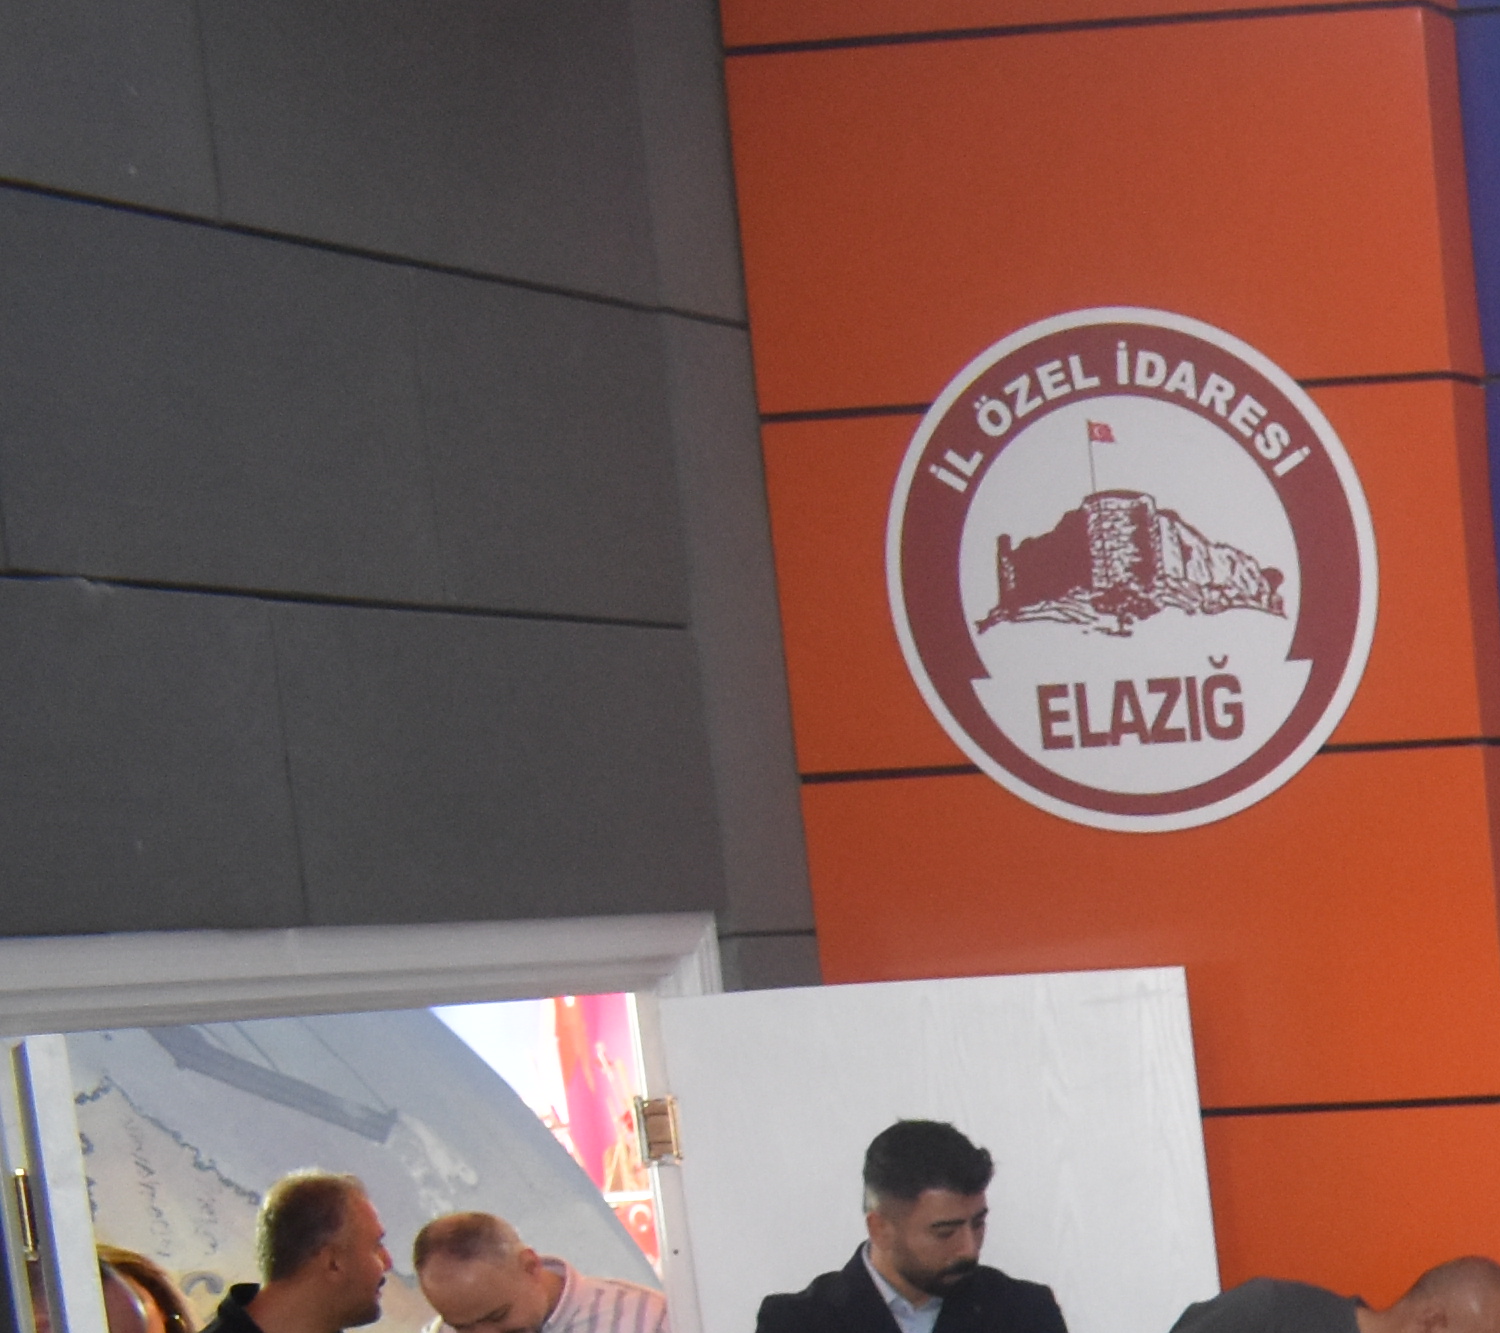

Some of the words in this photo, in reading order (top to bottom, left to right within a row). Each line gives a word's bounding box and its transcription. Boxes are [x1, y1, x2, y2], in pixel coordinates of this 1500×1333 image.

[930, 448, 983, 493] İL
[977, 354, 1100, 439] ÖZEL
[1115, 340, 1311, 478] İDARESİ
[1037, 654, 1245, 751] ELAZIĞ
